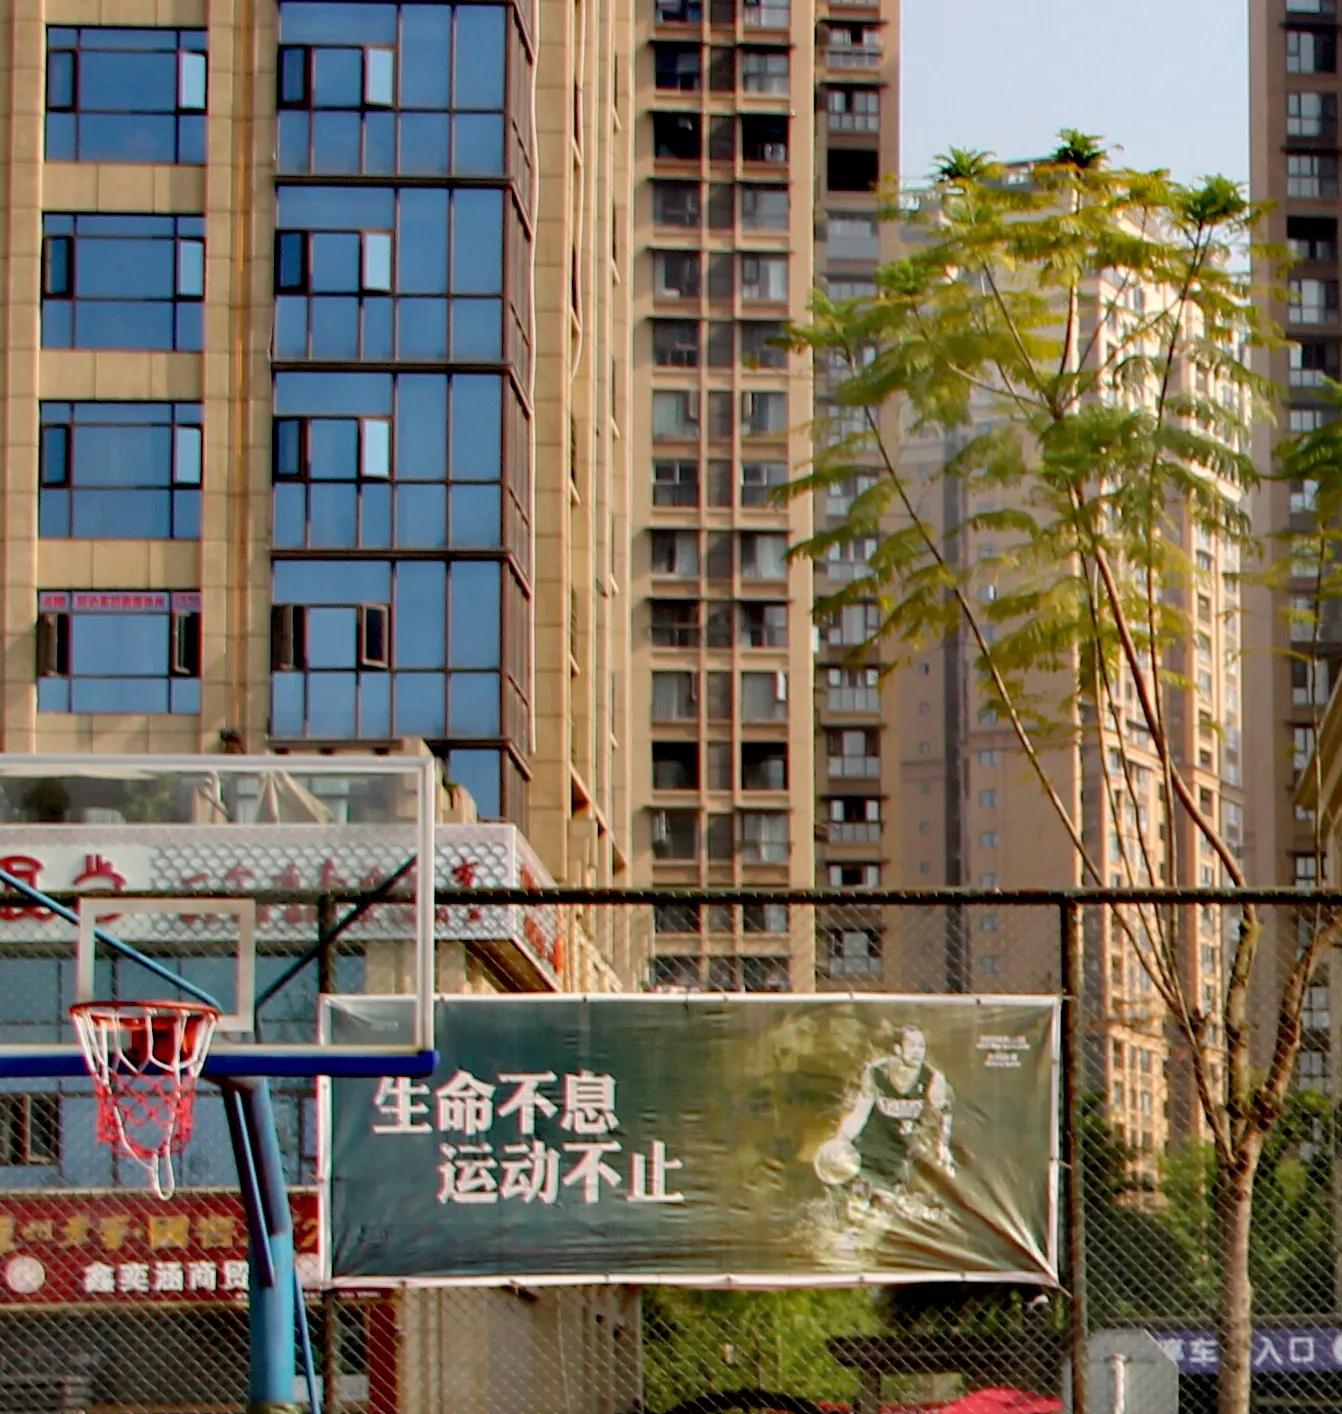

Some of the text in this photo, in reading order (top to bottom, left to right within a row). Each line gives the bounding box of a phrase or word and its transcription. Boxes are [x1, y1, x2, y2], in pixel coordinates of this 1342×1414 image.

[372, 1070, 619, 1135] 生命不息
[437, 1140, 685, 1204] 运动不止
